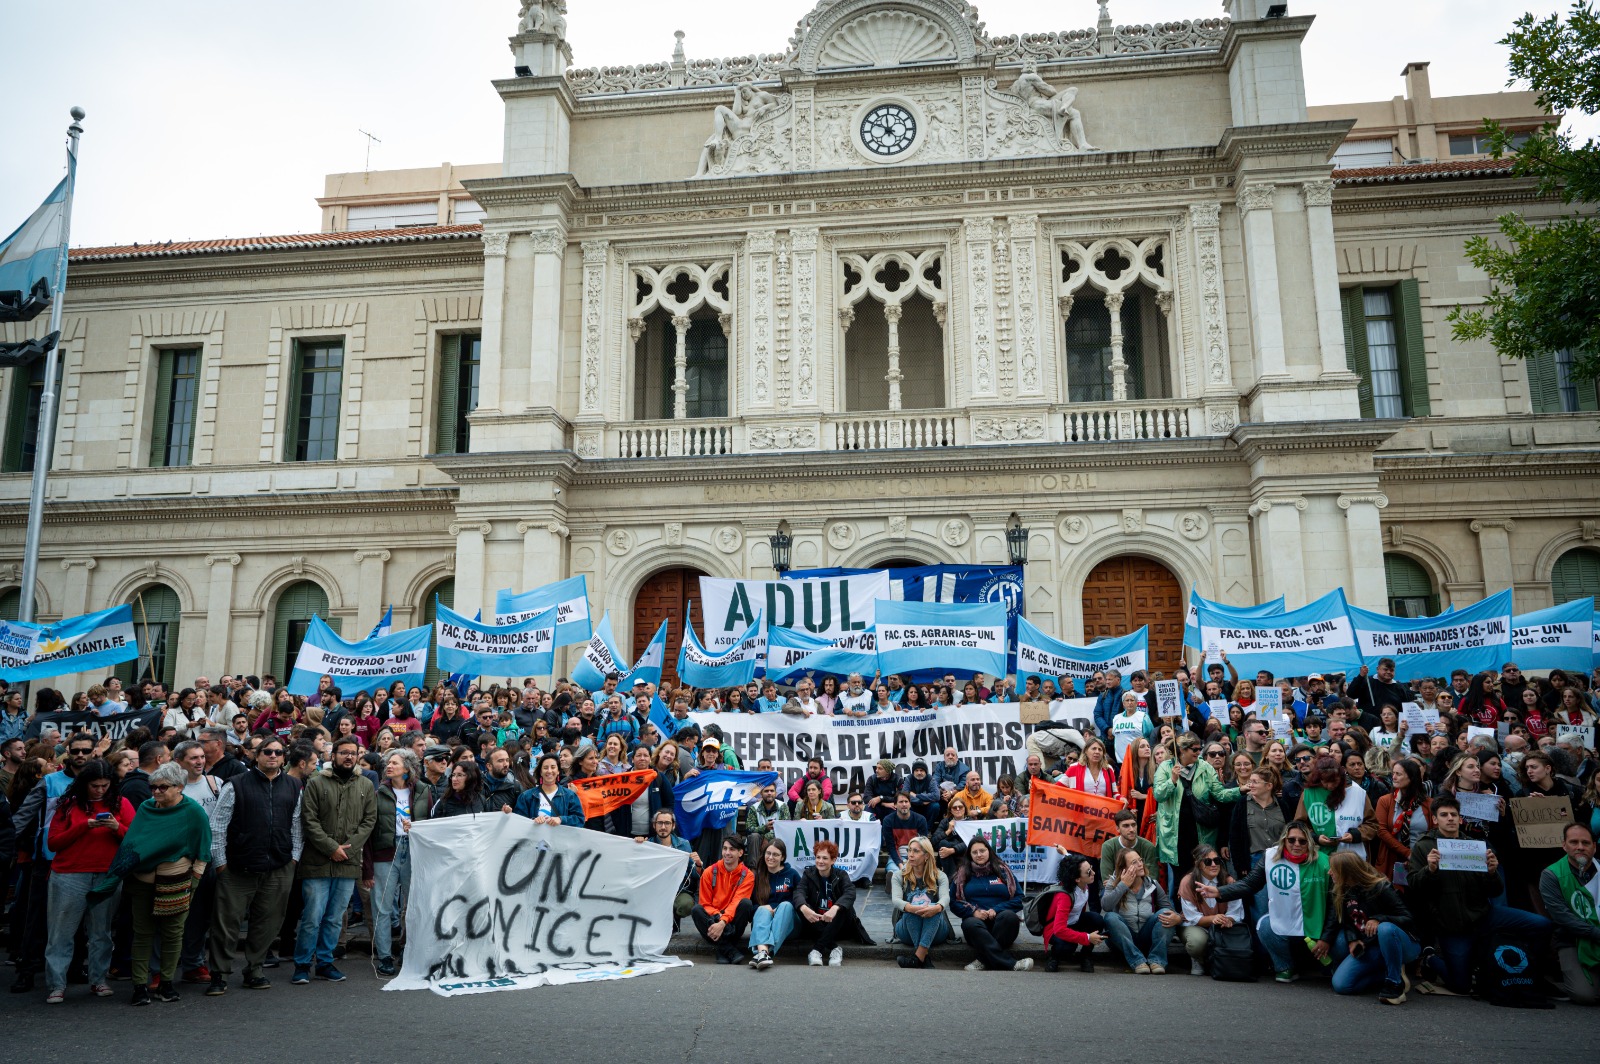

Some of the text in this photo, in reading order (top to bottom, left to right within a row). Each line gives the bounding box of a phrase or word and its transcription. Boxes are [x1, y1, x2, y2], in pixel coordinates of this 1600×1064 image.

[847, 477, 956, 497] NACIONAL
[1013, 473, 1097, 491] LITORAL
[724, 579, 866, 634] ADUL
[441, 623, 461, 640] FAC.
[463, 629, 479, 643] CS.
[536, 629, 551, 642] UNL
[884, 629, 902, 641] FAC.
[903, 629, 919, 639] CS.
[977, 629, 996, 641] UNL
[1219, 629, 1245, 639] FAC.
[1247, 629, 1272, 639] ING.
[1274, 627, 1303, 639] QCA.
[1312, 620, 1338, 634] UNL
[1373, 633, 1392, 648] FAC.
[1393, 628, 1459, 646] HUMANIDADES
[1459, 626, 1467, 642] Y
[1486, 620, 1506, 635] UNL
[1542, 623, 1572, 634] UNL
[3, 635, 31, 648] CIENCIA
[77, 639, 111, 655] SANTA
[112, 635, 126, 648] FE
[929, 639, 956, 647] FATUN
[961, 640, 978, 648] CGT
[1269, 640, 1301, 649] FATUN
[1305, 636, 1325, 646] CGT
[1429, 642, 1460, 653] FATUN
[1466, 638, 1486, 648] CGT
[1540, 636, 1561, 644] CGT
[486, 645, 516, 654] FATUN
[521, 645, 538, 653] CGT
[322, 653, 385, 666] RECTORADO
[395, 653, 417, 664] UNL
[1021, 647, 1037, 662] FAC.
[1038, 652, 1050, 666] CS.
[1052, 656, 1109, 672] VETERINARIAS
[1116, 656, 1132, 668] UNL
[356, 667, 385, 676] FATUN
[390, 666, 408, 674] CGT
[856, 717, 896, 727] SOLIDARIDAD
[1114, 721, 1136, 730] ADUL
[1580, 726, 1589, 734] LA
[838, 732, 872, 761] DE
[877, 729, 907, 759] LA
[601, 787, 632, 799] SALUD
[1032, 815, 1116, 843] SANTA FE
[498, 838, 629, 904] UNL
[1271, 866, 1293, 888] ATE
